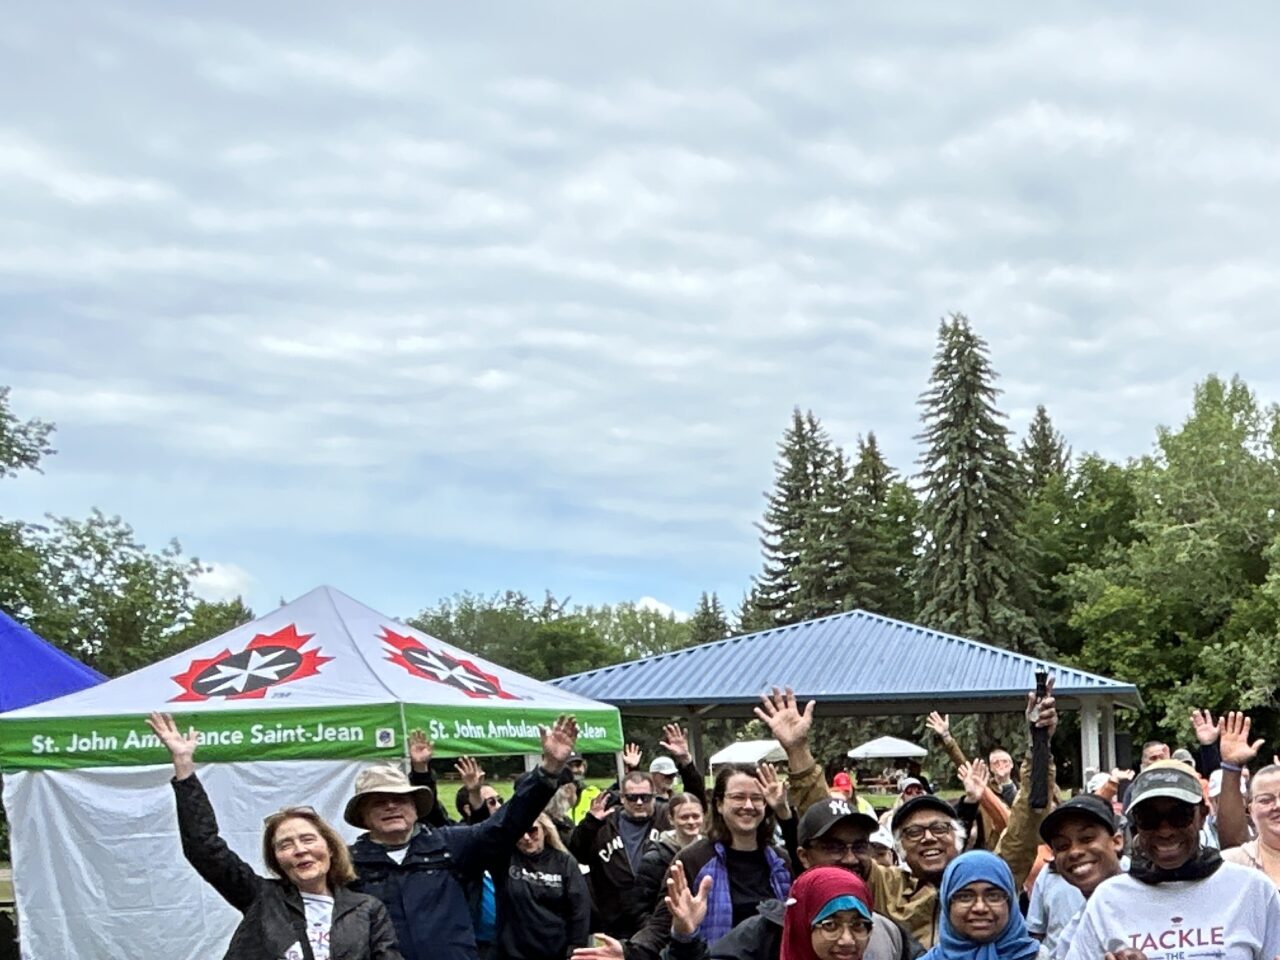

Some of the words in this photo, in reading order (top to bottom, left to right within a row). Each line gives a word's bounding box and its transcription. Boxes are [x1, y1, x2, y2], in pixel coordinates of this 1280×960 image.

[31, 734, 60, 754] St.
[66, 731, 117, 753] John
[250, 722, 364, 744] Saint-Jean
[429, 720, 449, 739] St.
[453, 719, 485, 738] John
[487, 719, 552, 739] Ambulan
[1128, 926, 1225, 951] TACKLE
[1165, 951, 1185, 960] THE
